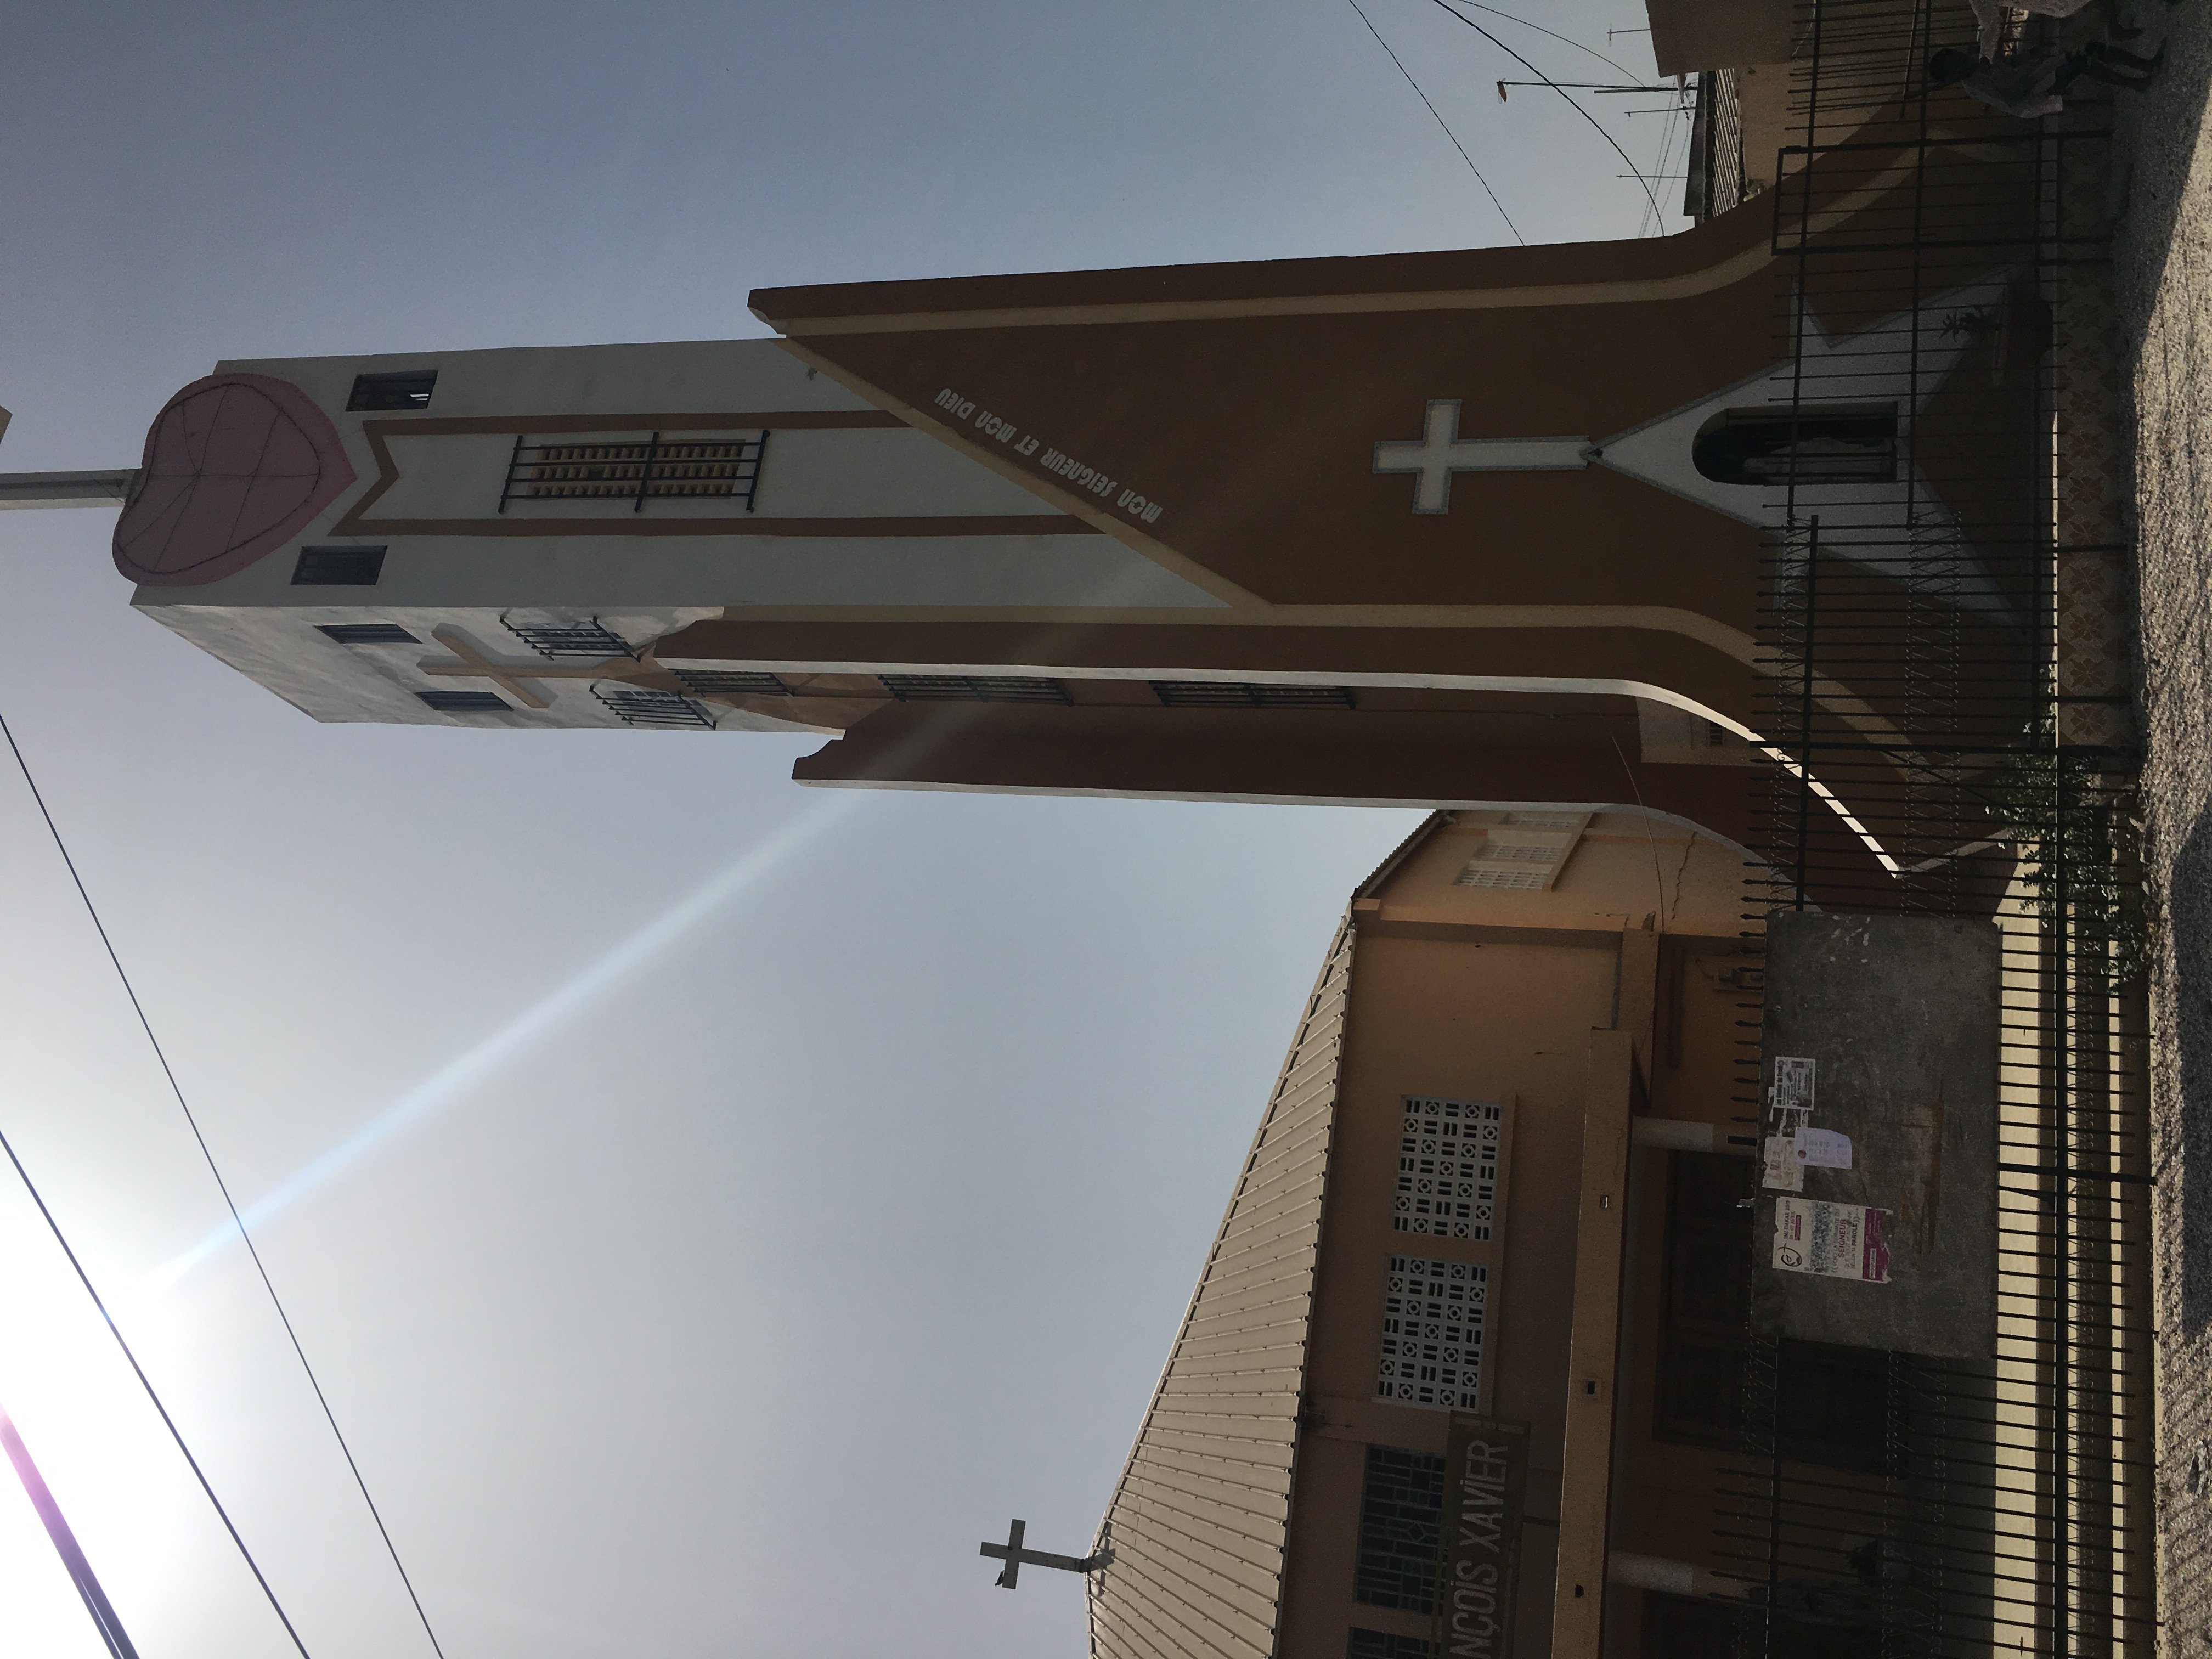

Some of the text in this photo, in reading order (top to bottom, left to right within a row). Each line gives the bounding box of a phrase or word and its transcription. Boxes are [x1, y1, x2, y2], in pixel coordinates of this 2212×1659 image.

[934, 389, 1164, 523] MON SEIGNEUR ET MON DIEU
